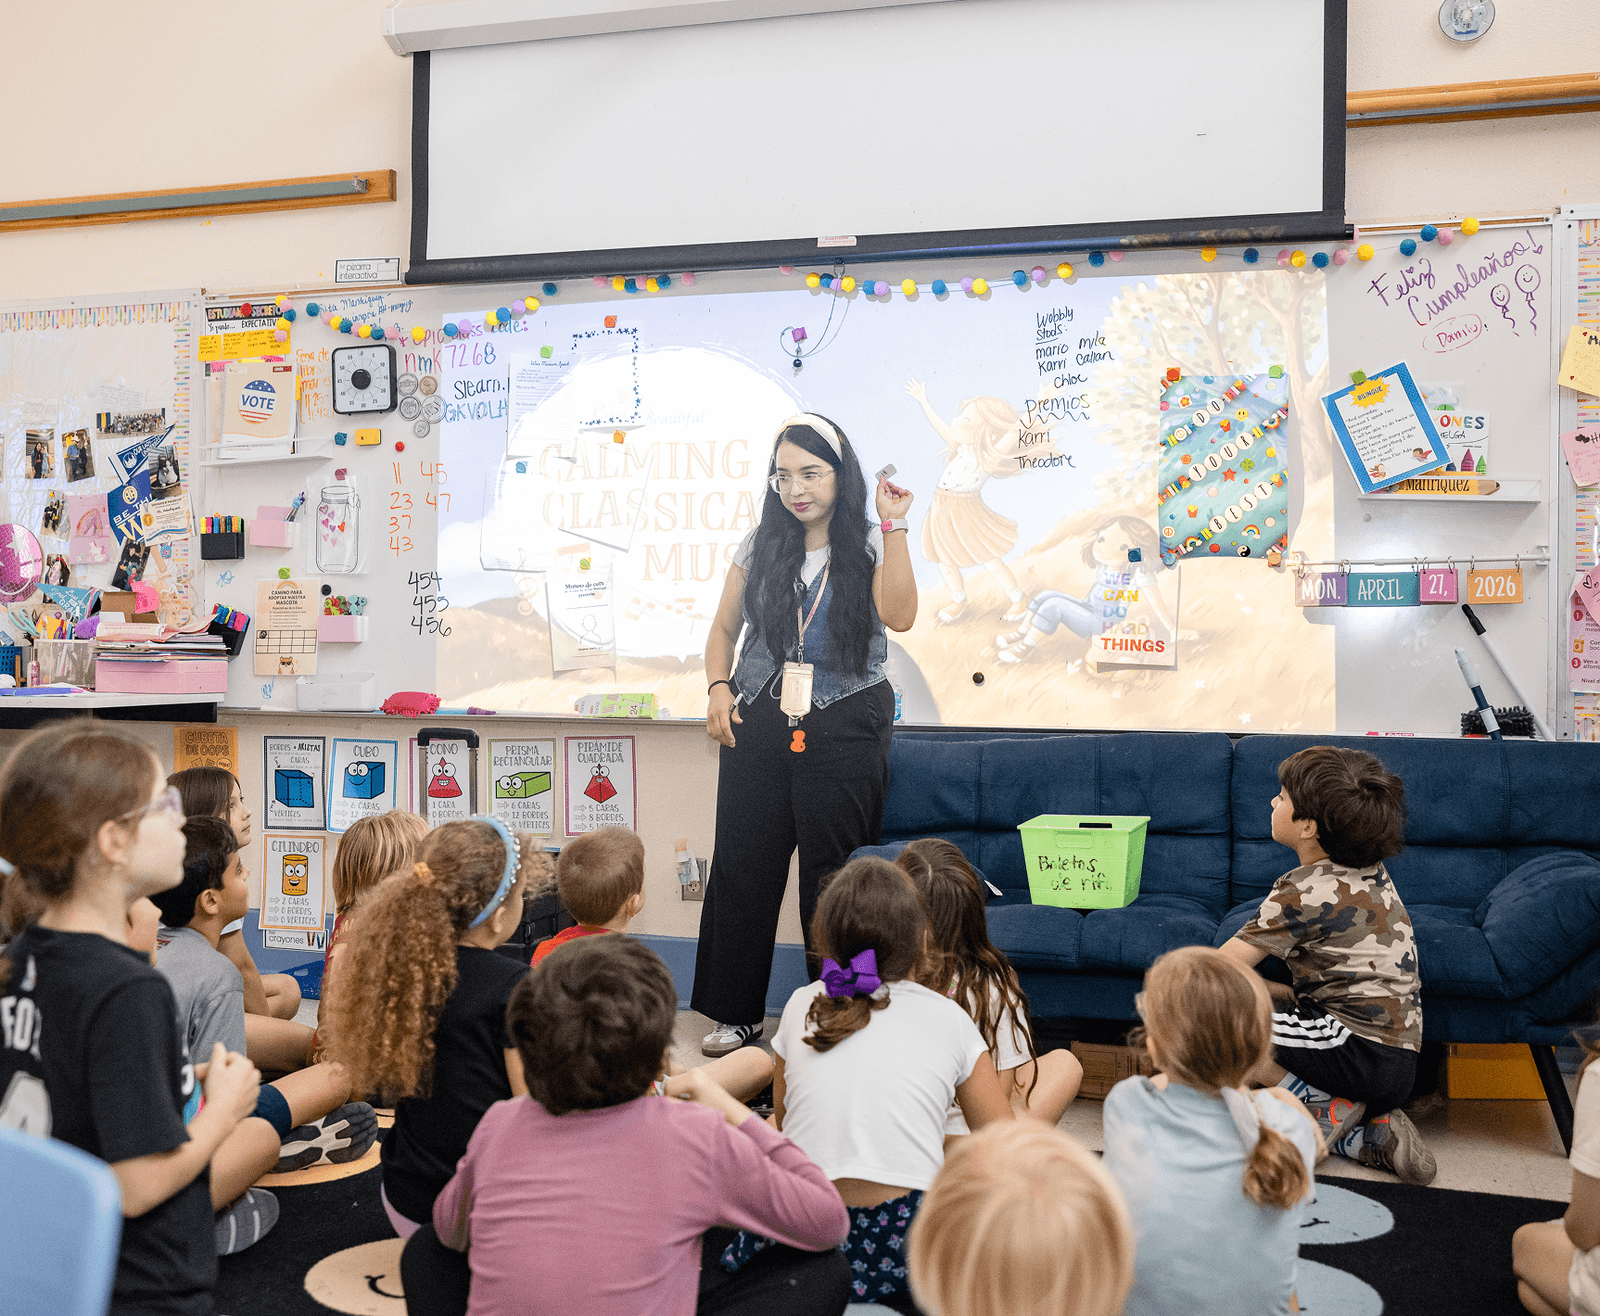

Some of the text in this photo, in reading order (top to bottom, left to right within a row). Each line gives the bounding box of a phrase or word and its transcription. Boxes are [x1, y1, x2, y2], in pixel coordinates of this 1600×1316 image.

[346, 263, 371, 272] pizarra
[340, 271, 378, 280] interactiva
[1367, 258, 1436, 307] Feliz
[208, 306, 243, 320] ESTUDIAN
[1037, 306, 1074, 328] Wobbly
[242, 319, 277, 328] EXPECTATIV
[445, 342, 496, 369] 7268
[242, 394, 275, 410] VOTE
[1440, 430, 1466, 439] ELGA
[539, 438, 752, 482] CALMING
[1014, 452, 1077, 469] Theodore
[1193, 434, 1251, 479] YOUR
[421, 461, 447, 485] 45
[390, 492, 451, 512] 23 47
[542, 488, 760, 532] CLASSICA
[389, 515, 411, 533] 37
[389, 536, 414, 557] 43
[408, 571, 443, 594] 454
[1105, 573, 1131, 586] WE
[1301, 574, 1517, 601] MON. APRIL 27, 2026
[1103, 589, 1139, 602] CAN
[413, 595, 449, 615] 455
[1103, 605, 1127, 618] DO
[411, 616, 452, 637] 456
[1102, 621, 1150, 635] HARD
[1101, 638, 1165, 653] THINGS
[630, 705, 638, 715] 24
[185, 731, 228, 744] CUBETA
[186, 745, 229, 756] DE OOPS
[353, 745, 379, 758] CUBO
[429, 743, 459, 756] CONO
[505, 745, 540, 756] PRISMA
[493, 755, 553, 767] RECTANGULAR
[577, 752, 624, 764] CUADRADA
[358, 802, 380, 811] CARAS
[438, 801, 456, 809] CARA
[511, 801, 541, 810] 6 CARAS
[596, 804, 620, 812] CARAS
[512, 811, 549, 820] 12 BORDES
[271, 840, 320, 853] CILINDRO
[282, 897, 310, 906] 2 CARAS
[287, 907, 312, 915] BORDES
[269, 934, 304, 945] crayones
